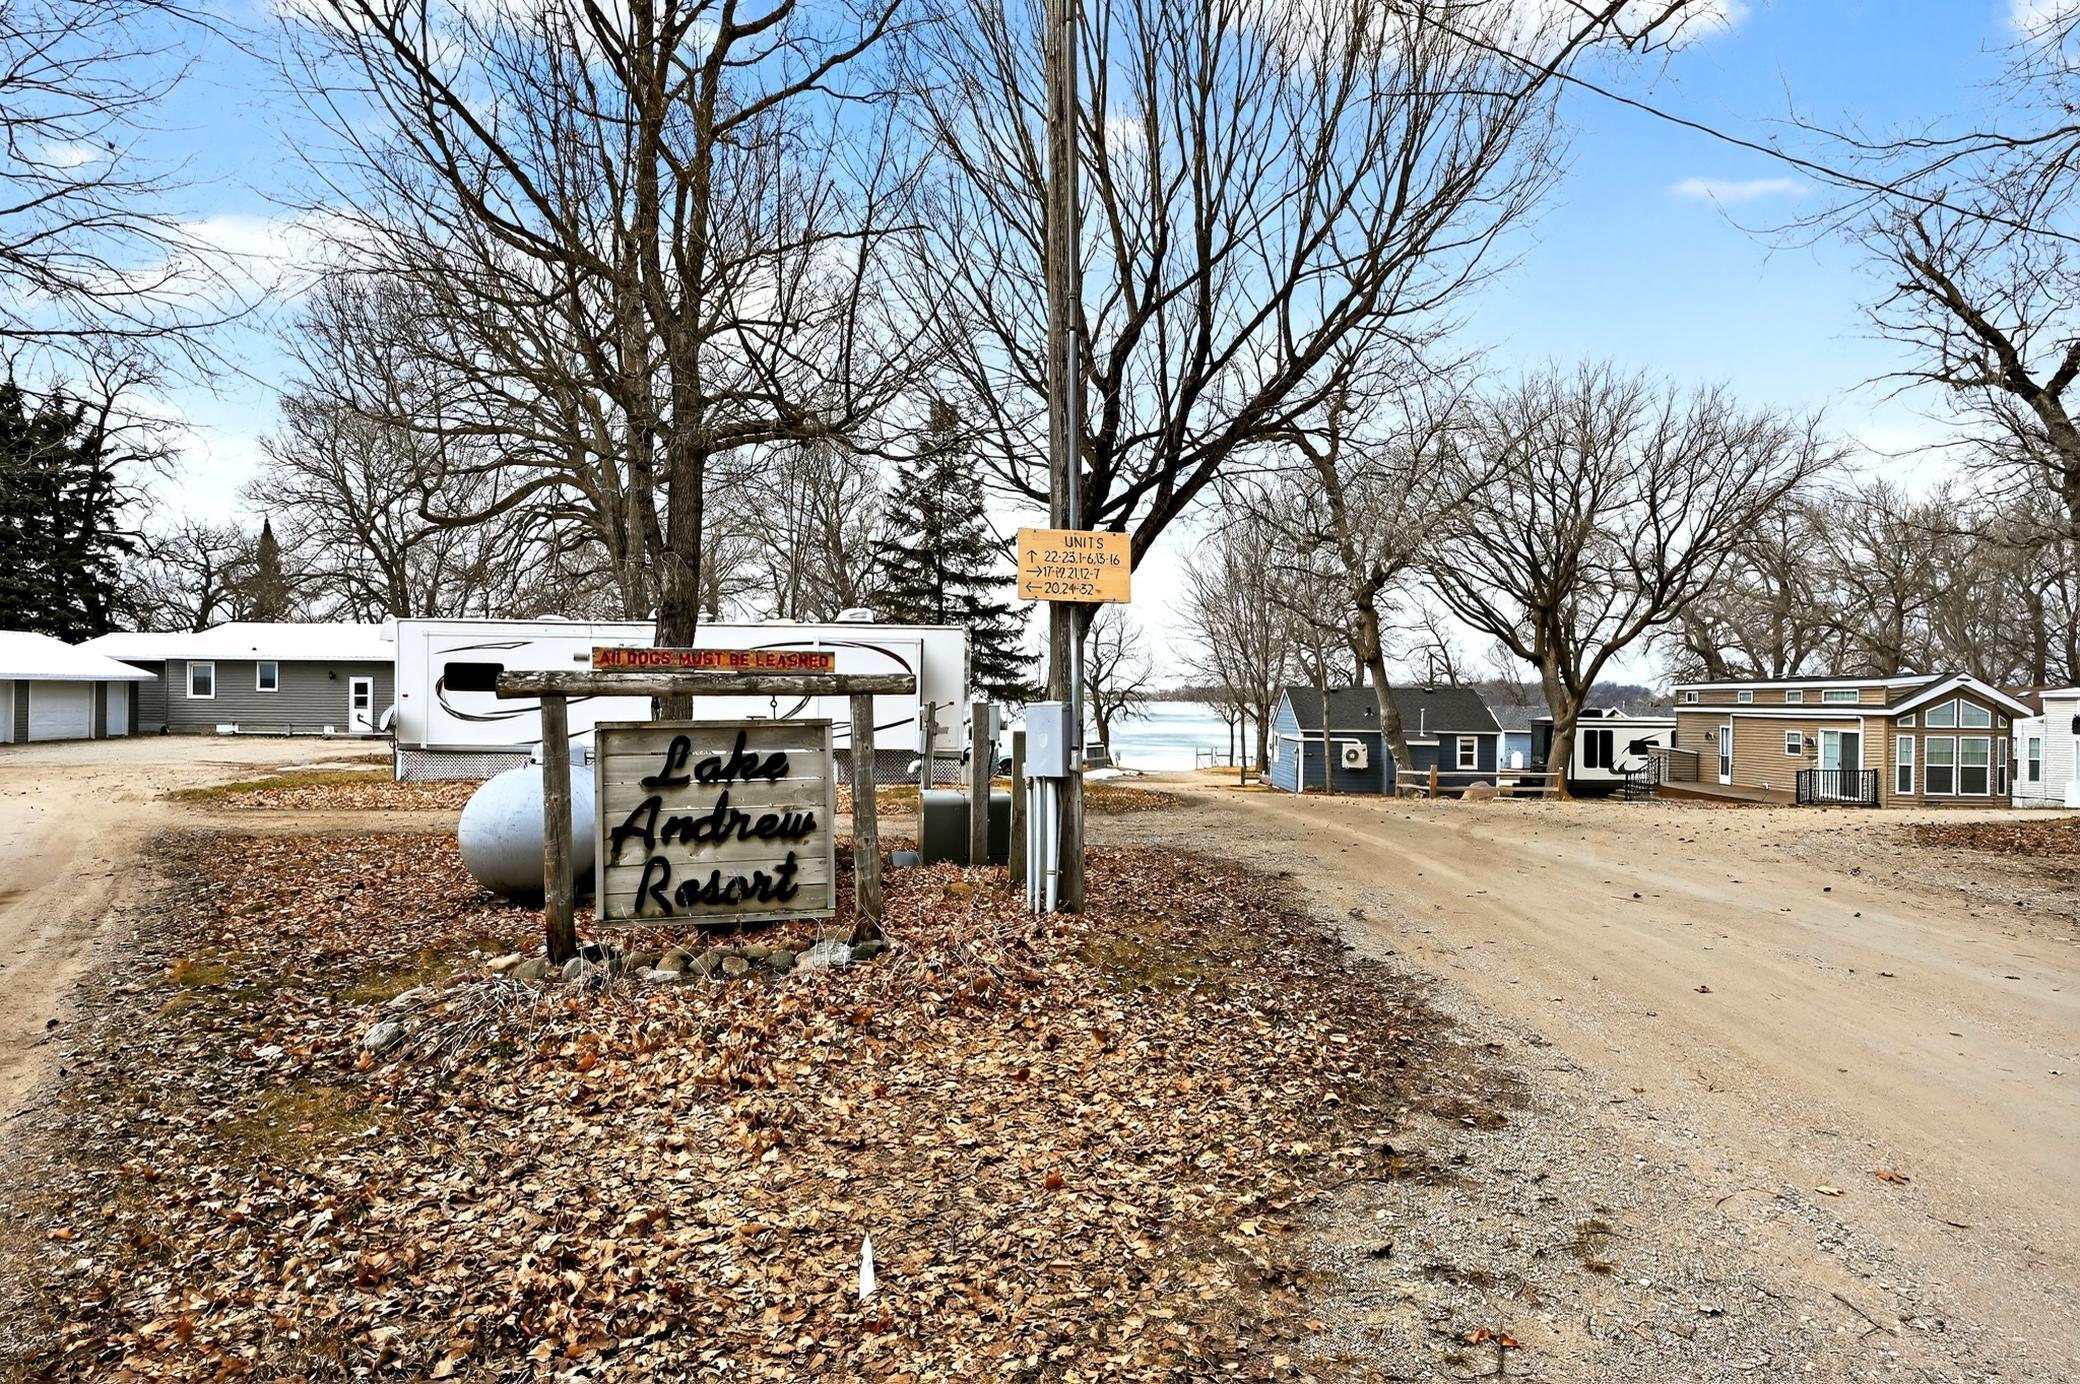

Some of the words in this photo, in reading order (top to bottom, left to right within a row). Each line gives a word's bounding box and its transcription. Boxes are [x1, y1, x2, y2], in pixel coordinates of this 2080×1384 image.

[1064, 536, 1104, 550] UNITS
[628, 651, 671, 665] DOGS
[679, 652, 724, 666] MUST
[729, 653, 750, 666] BE
[755, 653, 829, 668] LEASHED
[640, 730, 790, 787] Lake
[611, 789, 817, 856] Andrew
[634, 851, 799, 914] Resort
